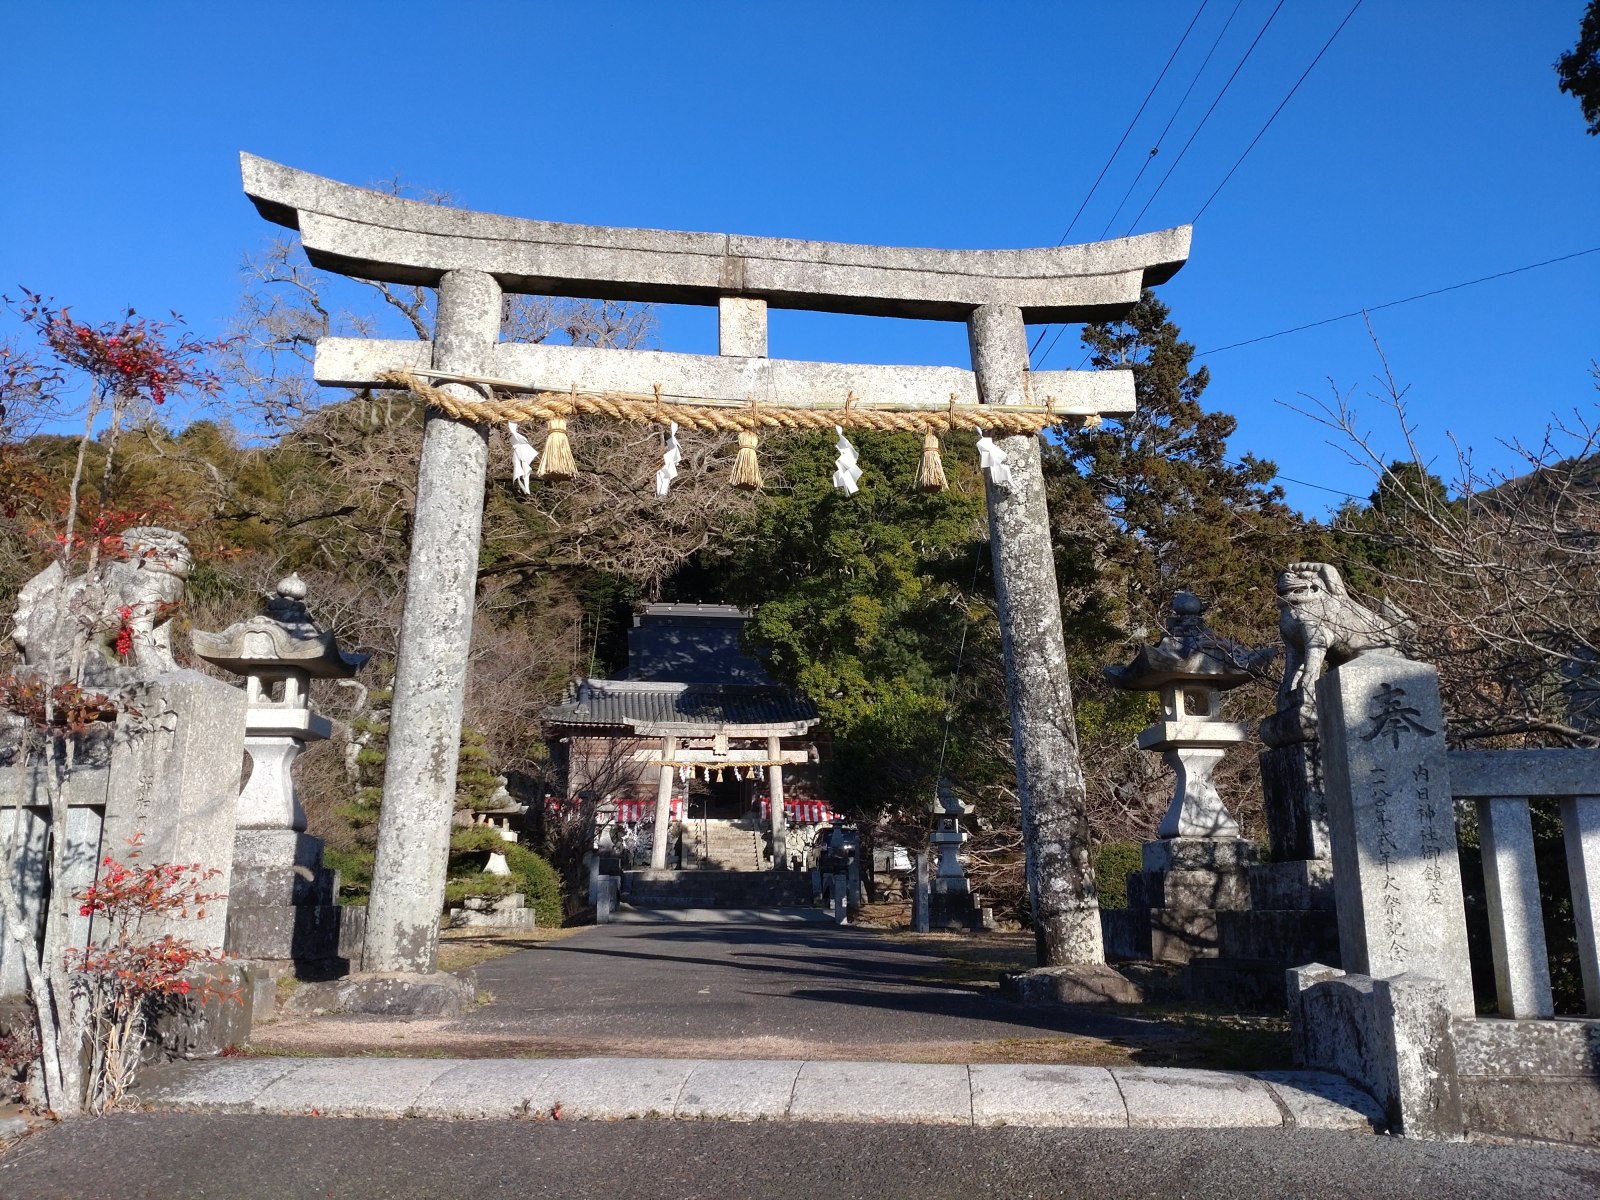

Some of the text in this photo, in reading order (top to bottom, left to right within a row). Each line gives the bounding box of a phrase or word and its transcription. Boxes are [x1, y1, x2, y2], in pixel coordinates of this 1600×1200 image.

[1359, 682, 1437, 752] 奉
[1411, 764, 1445, 906] 内日神社御鎮座
